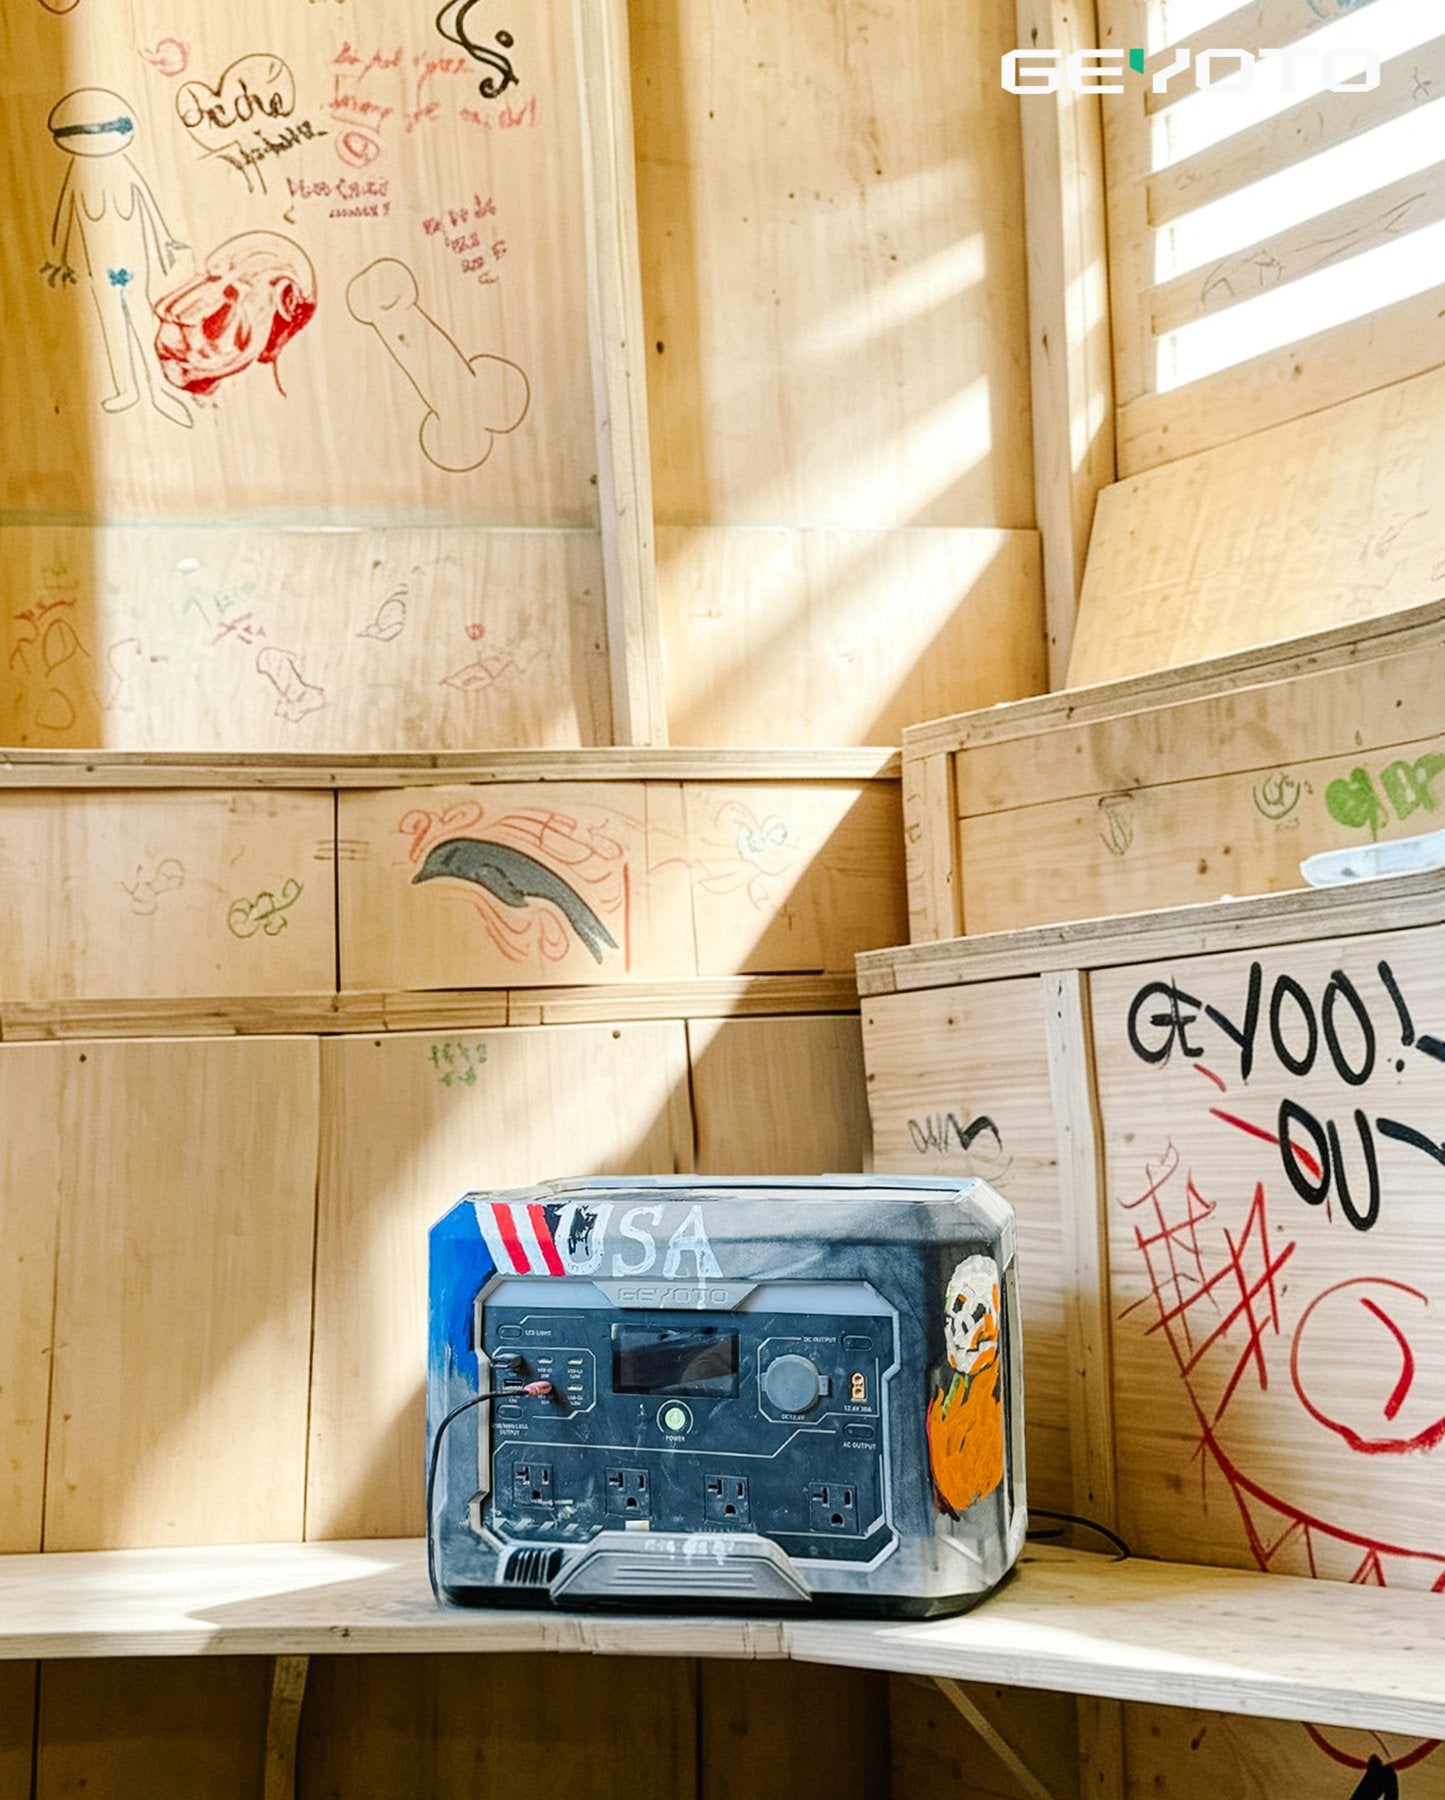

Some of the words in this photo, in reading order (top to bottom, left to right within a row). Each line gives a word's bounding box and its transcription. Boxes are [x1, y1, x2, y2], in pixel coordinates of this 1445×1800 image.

[554, 1201, 723, 1278] USA
[617, 1287, 729, 1305] GEYOTO
[843, 1441, 852, 1449] AC
[853, 1442, 877, 1450] OUTPUT
